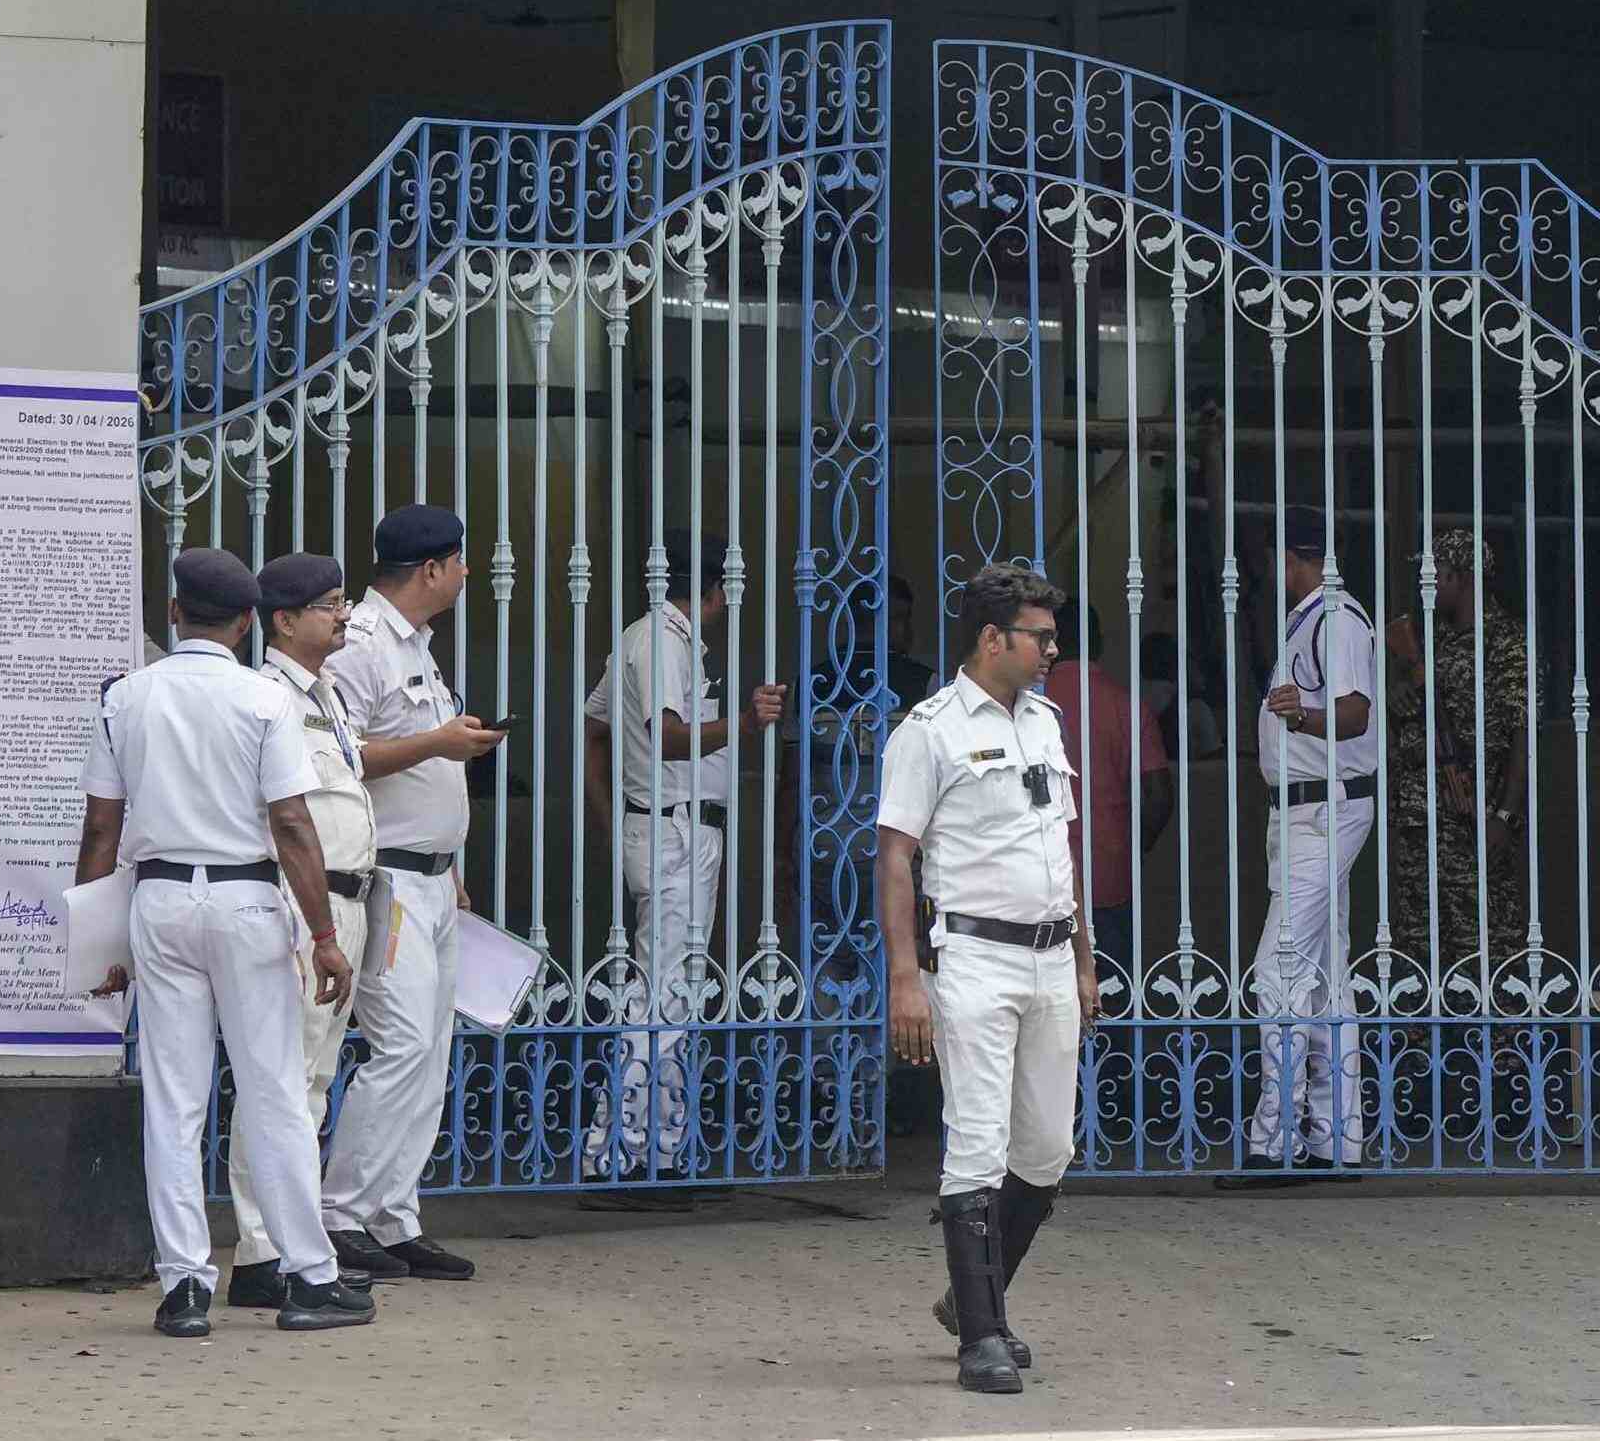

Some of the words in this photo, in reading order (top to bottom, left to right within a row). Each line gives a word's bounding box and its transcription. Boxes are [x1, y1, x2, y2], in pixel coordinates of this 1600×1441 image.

[18, 412, 55, 424] Dated:
[59, 413, 73, 425] 30
[83, 414, 96, 425] 04
[106, 415, 134, 427] 2026
[4, 837, 18, 845] the
[20, 837, 55, 846] relevant
